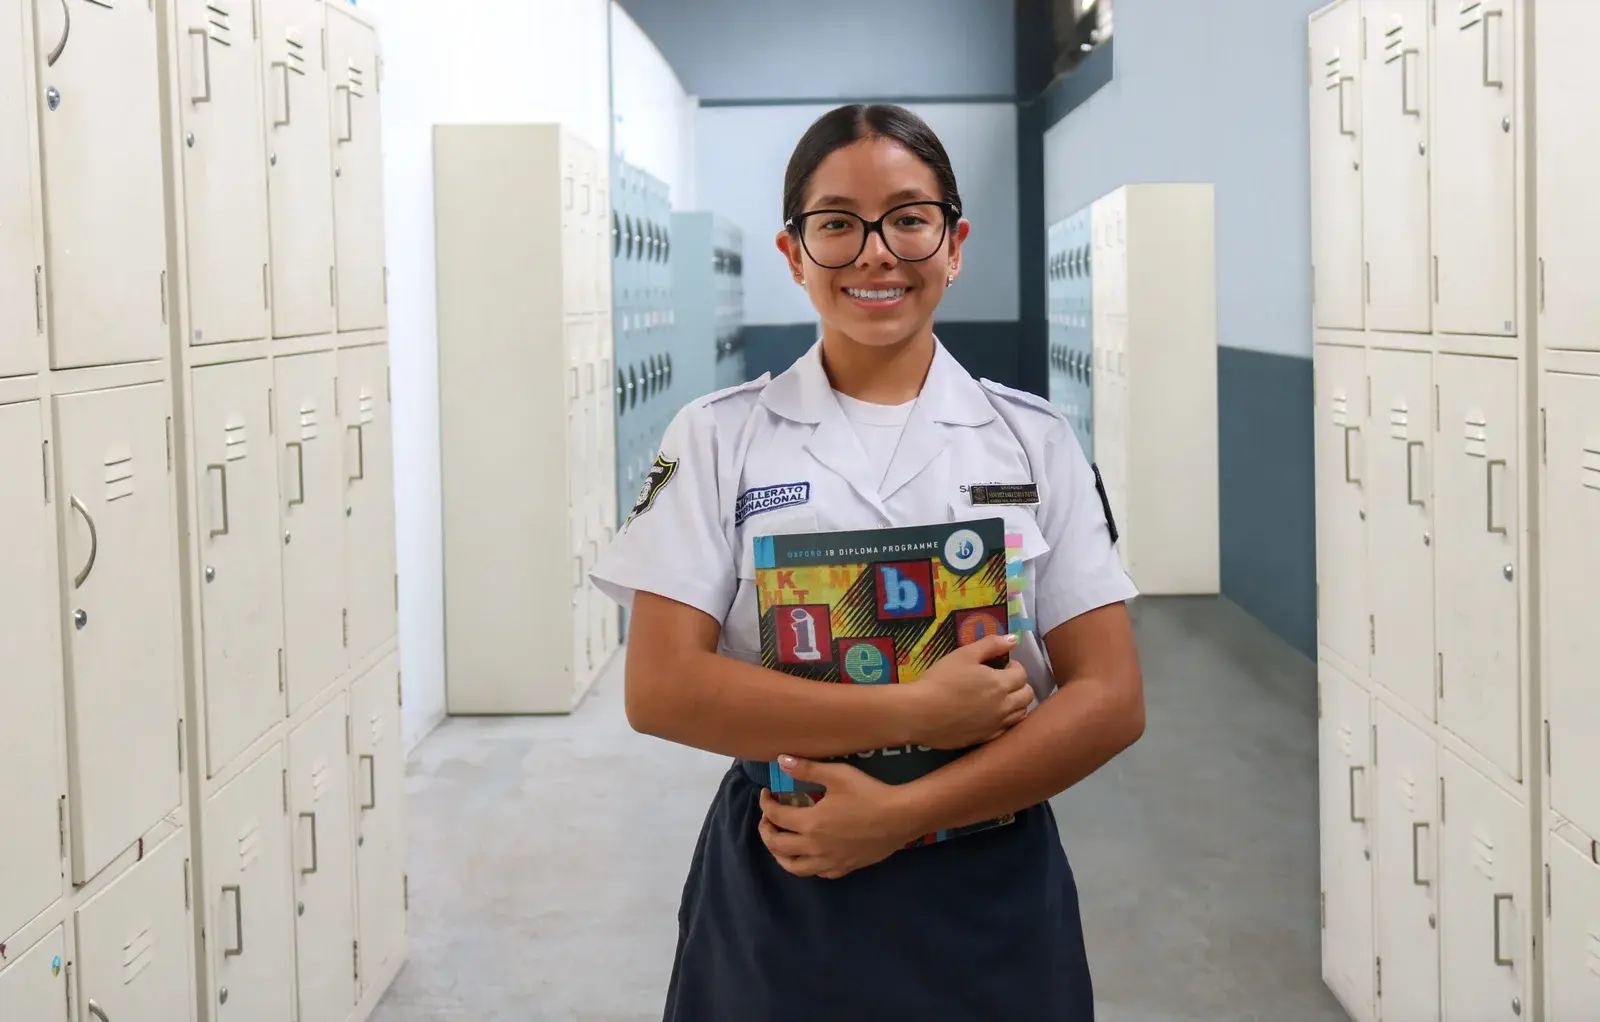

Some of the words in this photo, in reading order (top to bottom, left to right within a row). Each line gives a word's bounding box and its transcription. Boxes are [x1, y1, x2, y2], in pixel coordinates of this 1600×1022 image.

[734, 493, 804, 520] NTERNACIONAL
[787, 549, 822, 559] OXFORD
[825, 549, 835, 557] IB
[839, 546, 879, 556] DIPLOMA
[882, 541, 939, 553] PROGRAMME
[880, 565, 922, 613] b
[791, 608, 821, 660] i
[844, 642, 884, 684] e
